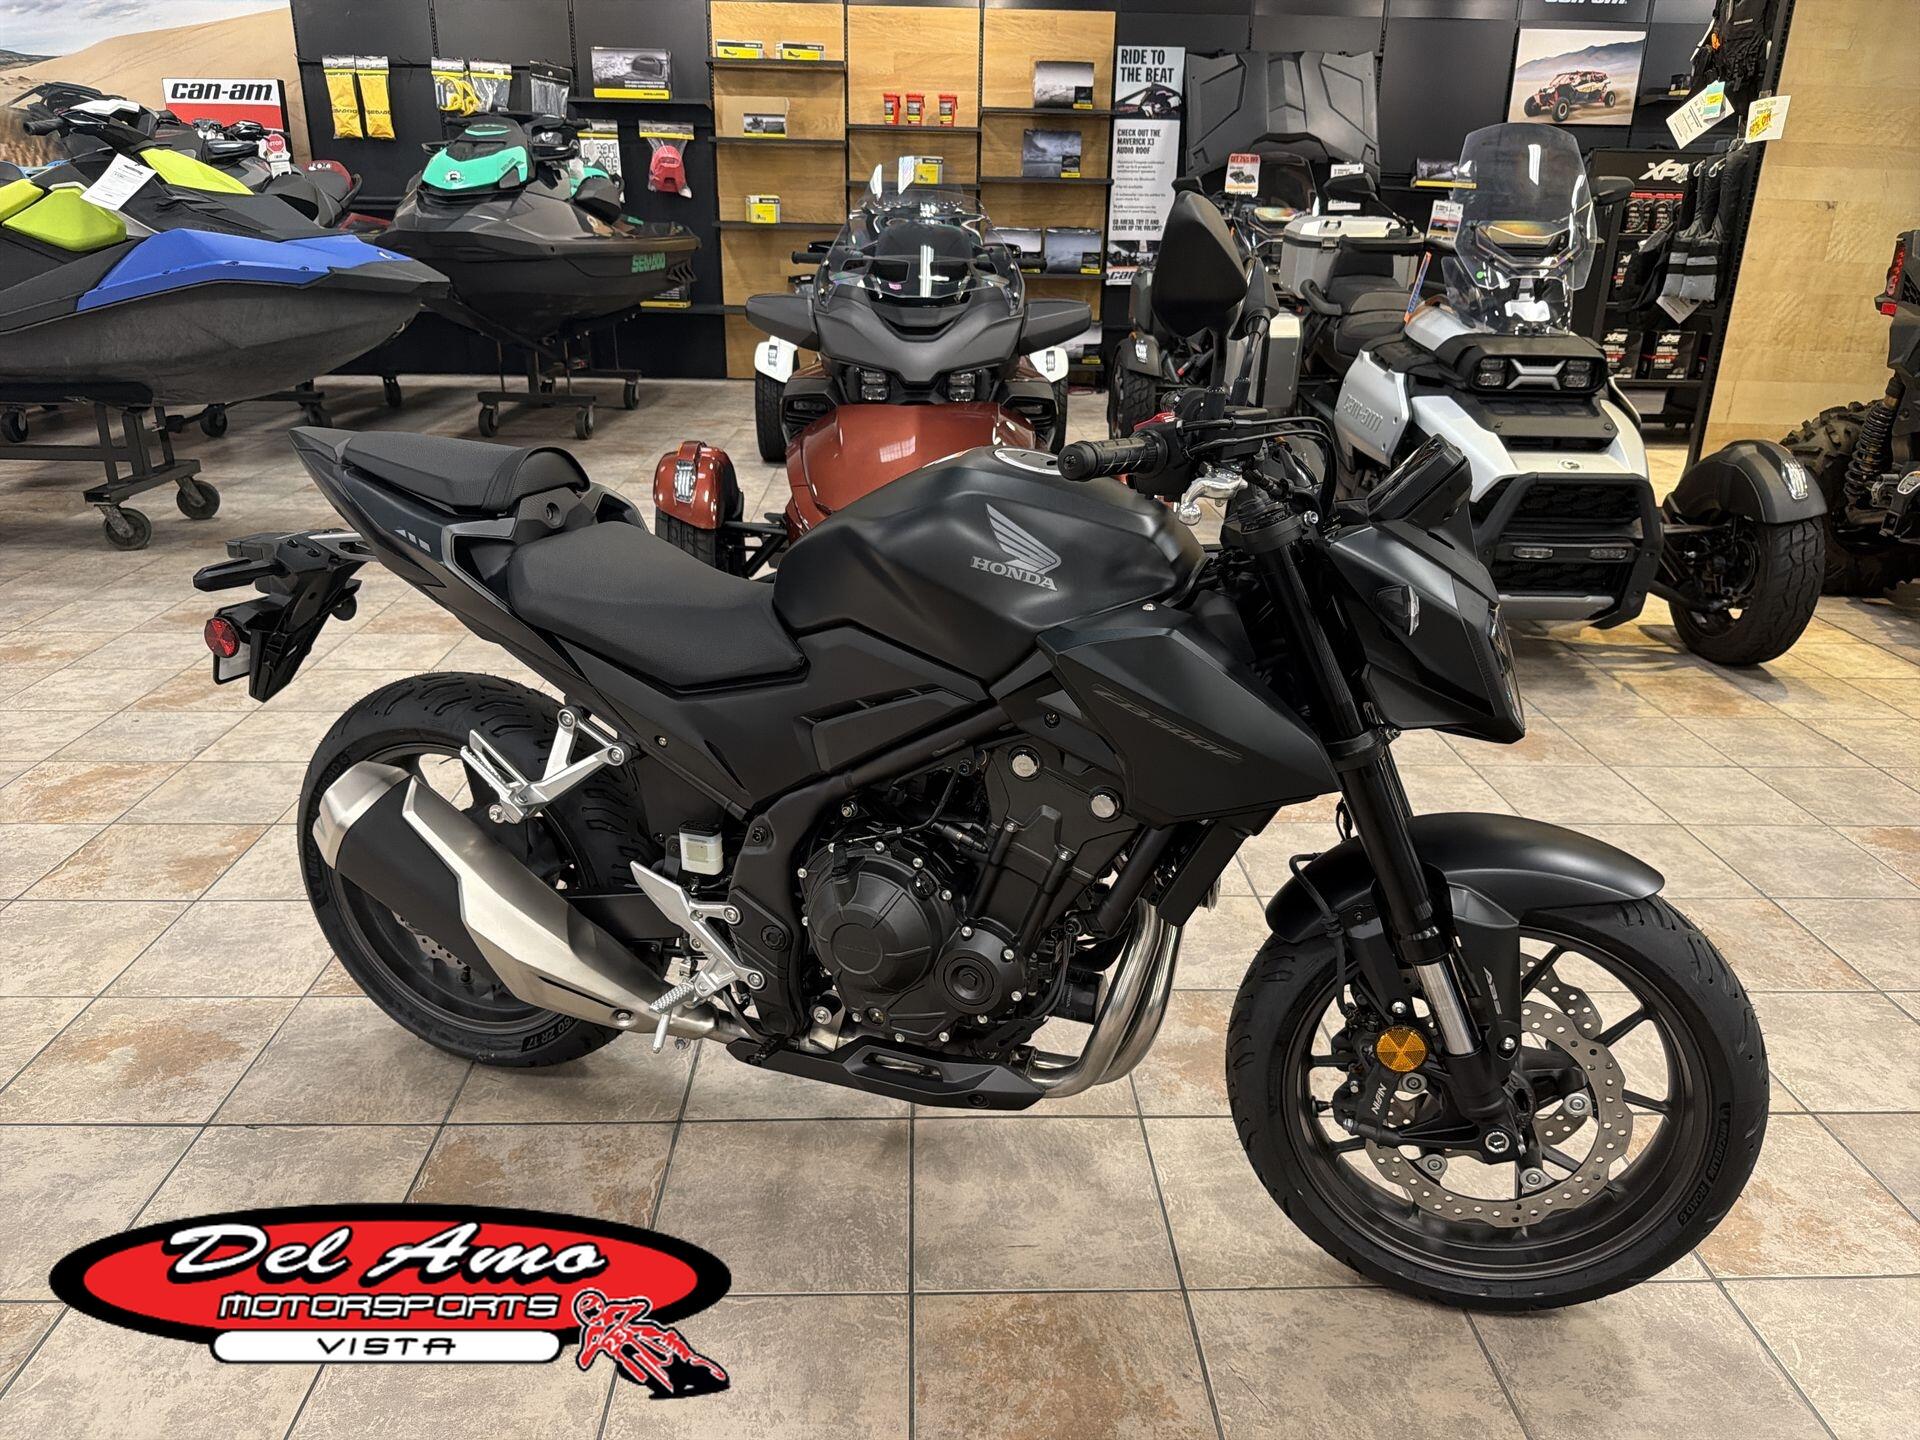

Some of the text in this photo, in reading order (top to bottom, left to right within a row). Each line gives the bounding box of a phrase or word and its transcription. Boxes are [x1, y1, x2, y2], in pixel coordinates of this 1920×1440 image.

[1121, 49, 1165, 65] RIDE TO
[1120, 67, 1174, 83] THE BEAT
[171, 82, 272, 101] can-am
[1117, 129, 1161, 137] CHECK OUT THE
[1117, 138, 1146, 146] MAVERICK
[970, 555, 1059, 592] HONDA
